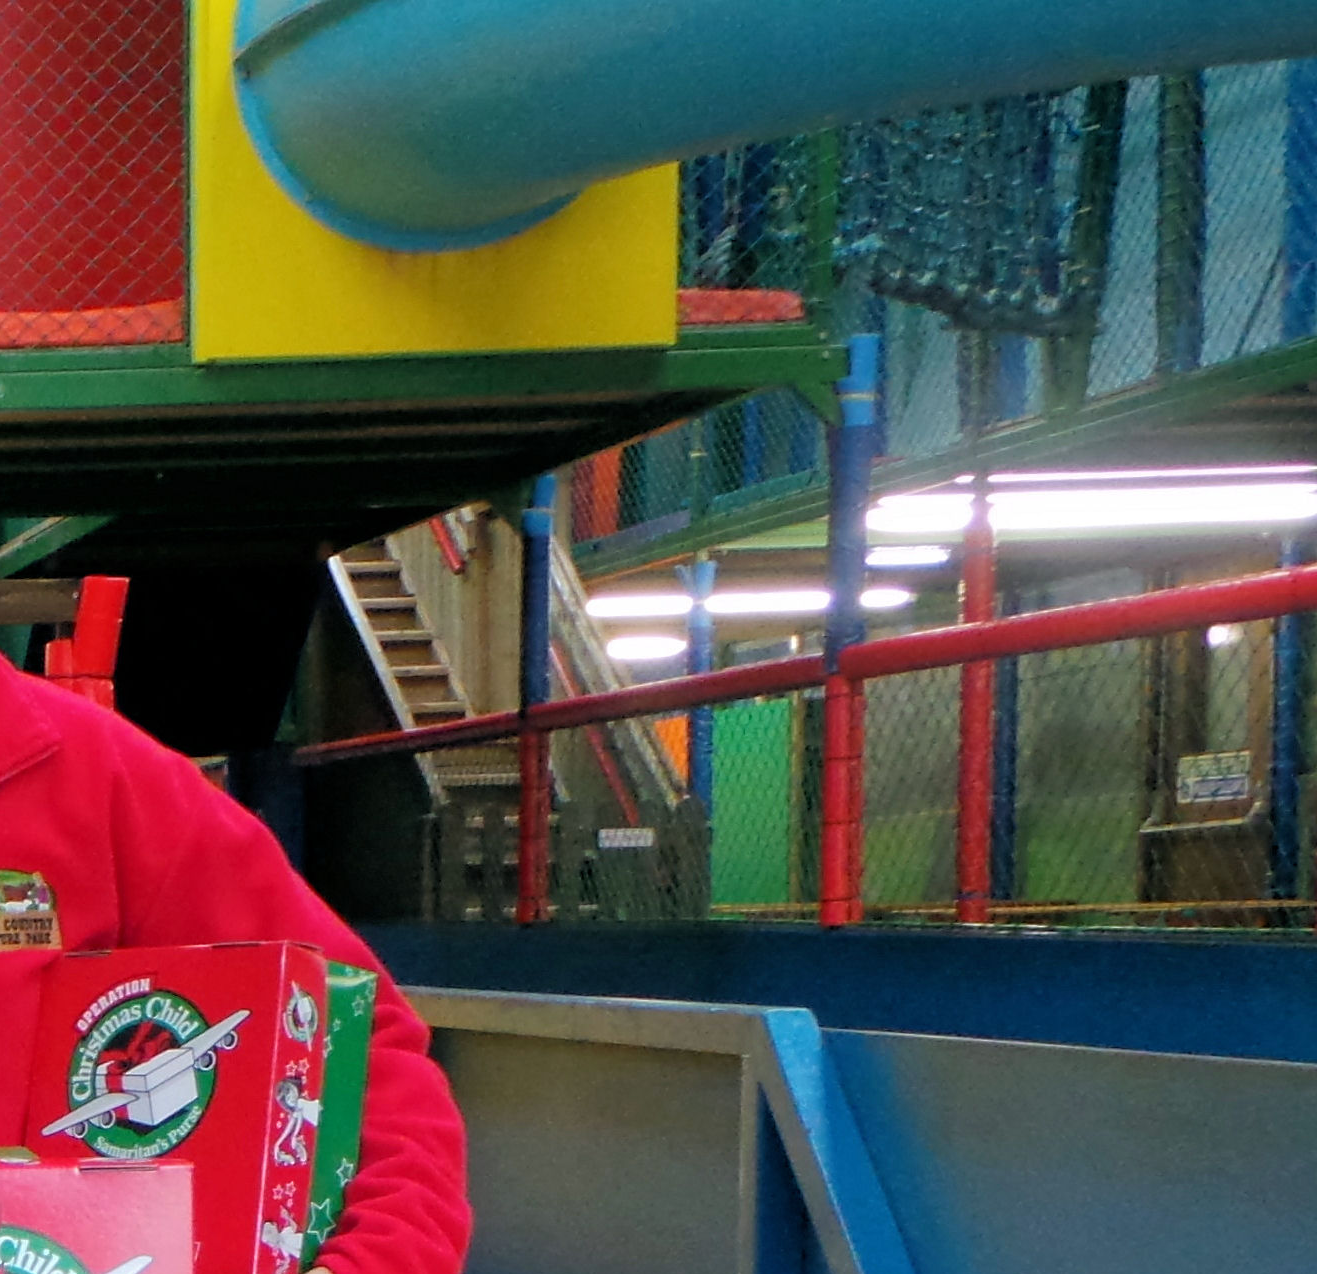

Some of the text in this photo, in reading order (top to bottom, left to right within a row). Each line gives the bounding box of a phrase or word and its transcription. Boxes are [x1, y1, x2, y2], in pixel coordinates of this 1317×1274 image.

[4, 918, 53, 931] COUNTRY
[77, 978, 151, 1032] OPERATION
[71, 996, 197, 1100] Christmas Child
[94, 1106, 202, 1159] Samaritan's Purse
